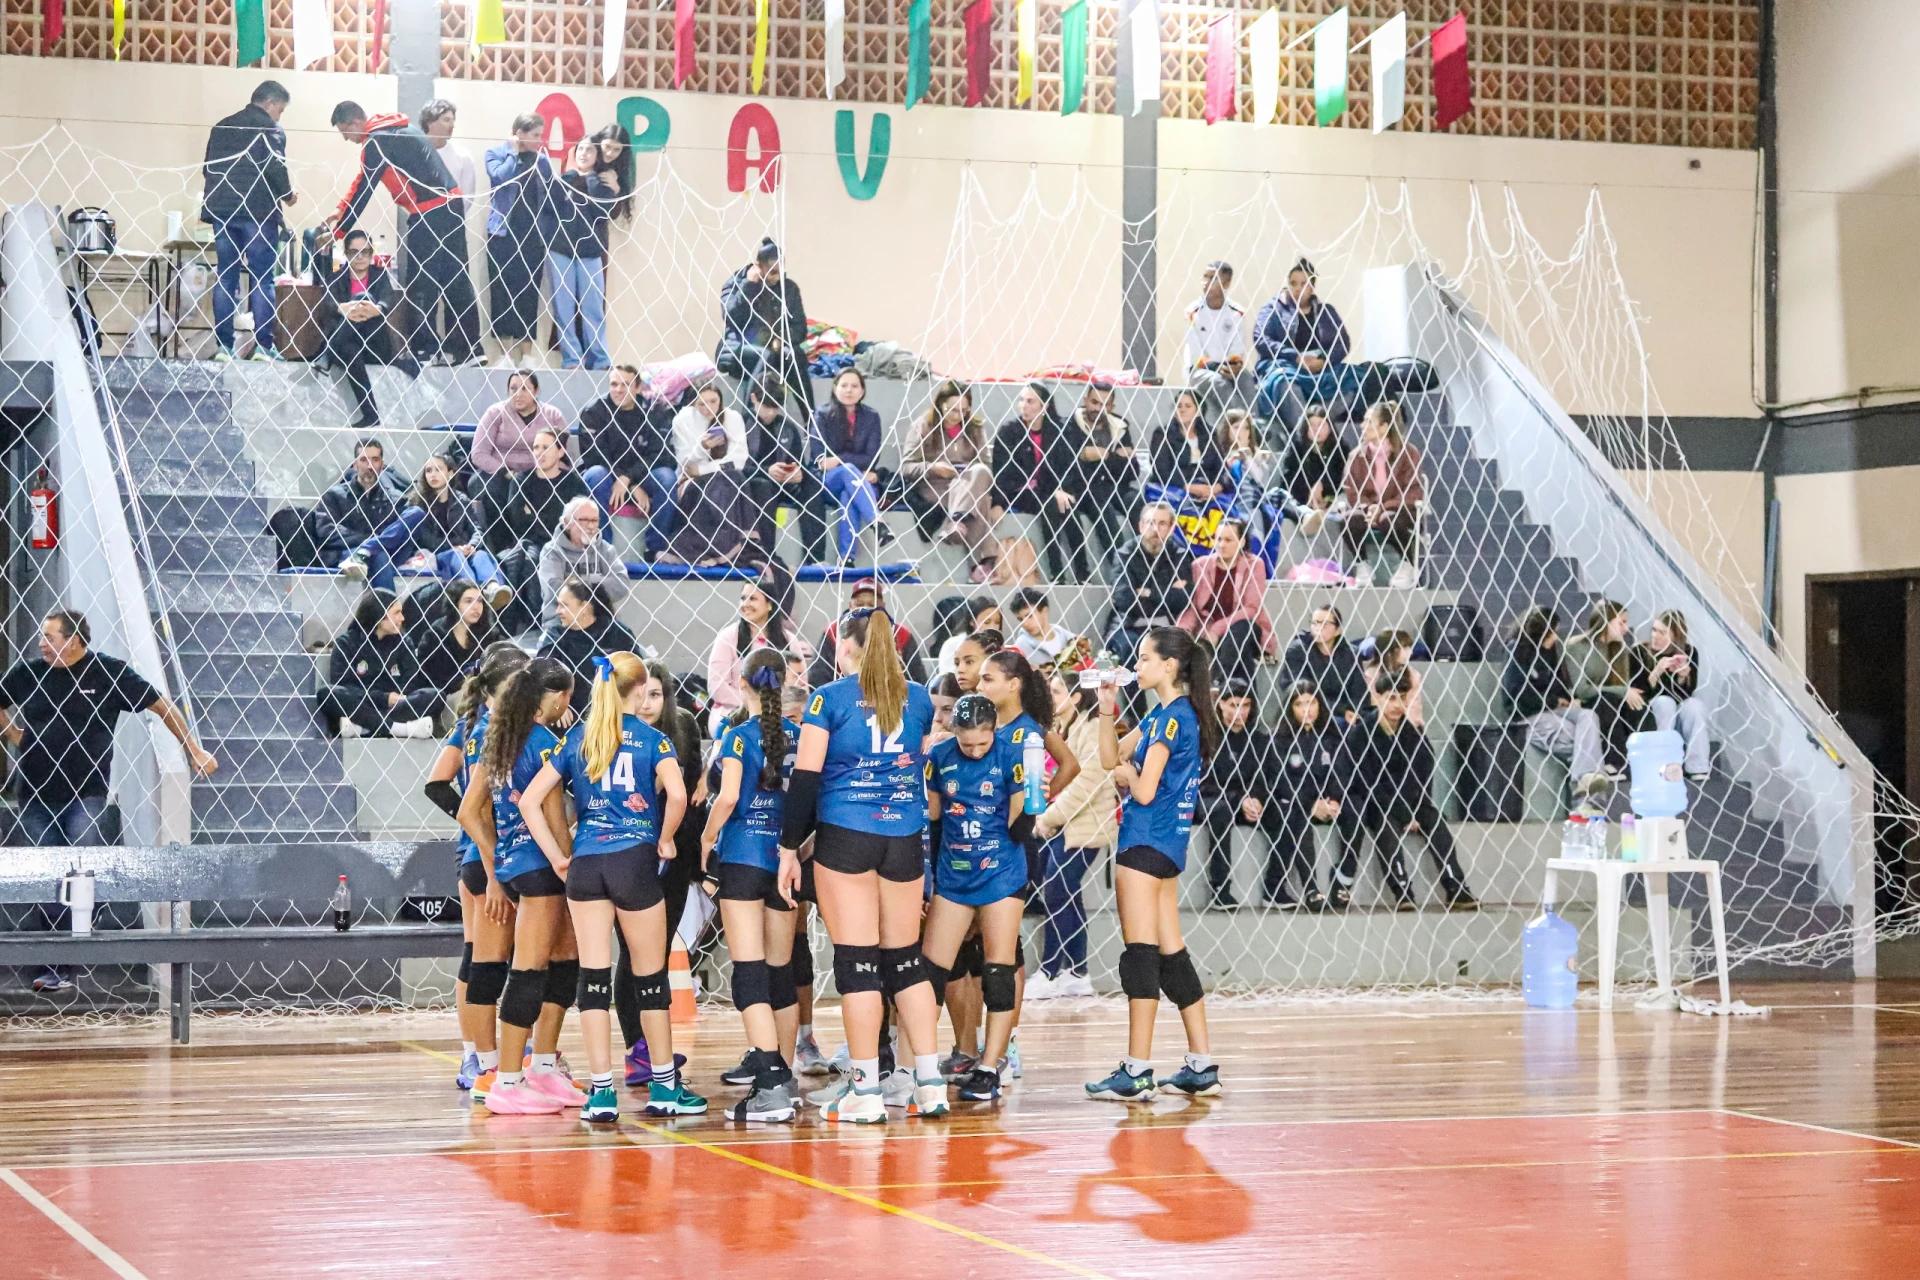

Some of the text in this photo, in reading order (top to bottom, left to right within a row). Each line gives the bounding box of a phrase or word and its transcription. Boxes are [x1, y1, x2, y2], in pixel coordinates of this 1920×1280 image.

[866, 714, 904, 753] 12
[601, 752, 636, 792] 14
[961, 820, 981, 838] 16
[419, 900, 442, 916] 105
